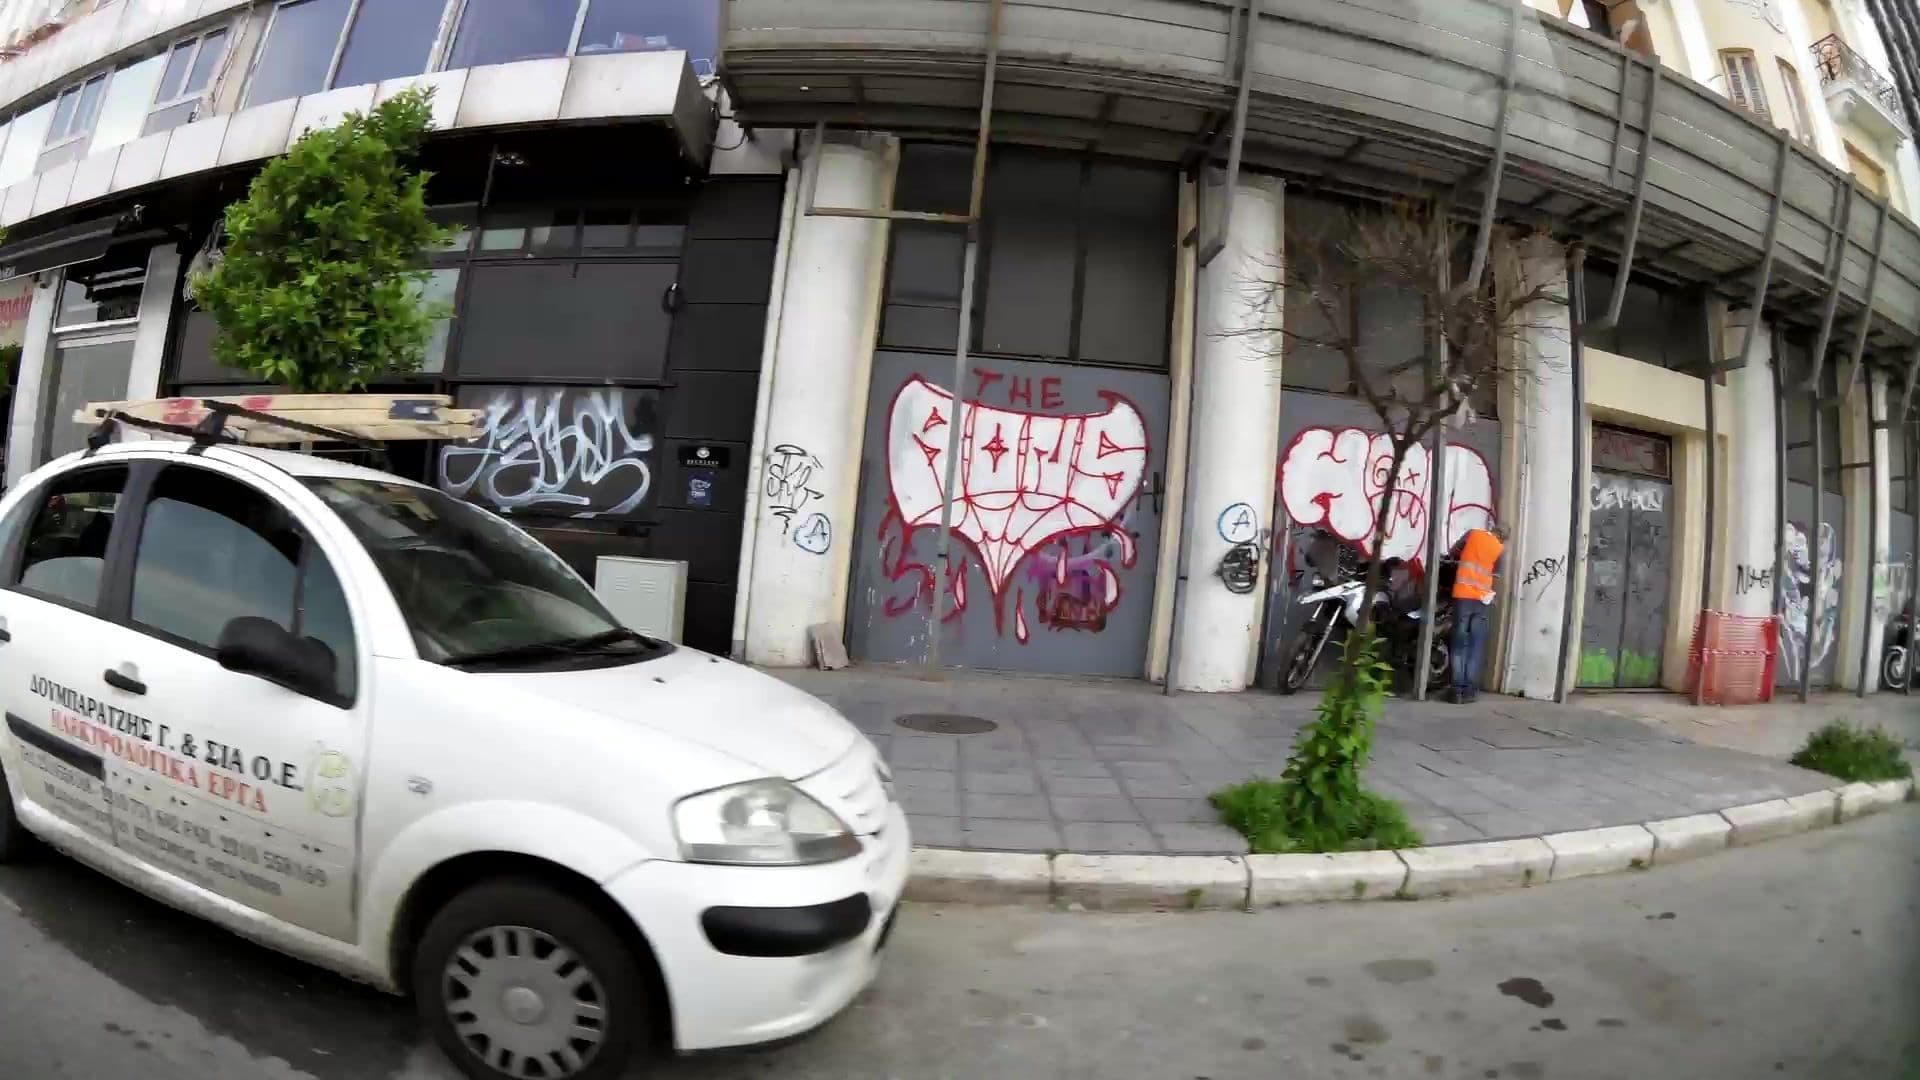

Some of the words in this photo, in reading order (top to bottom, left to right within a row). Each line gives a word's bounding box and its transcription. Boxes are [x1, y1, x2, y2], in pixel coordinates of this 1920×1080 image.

[972, 366, 1064, 410] THE
[180, 733, 198, 758] &
[205, 739, 245, 774] ΣΙΑ
[207, 770, 268, 813] ΕΡΓΑ
